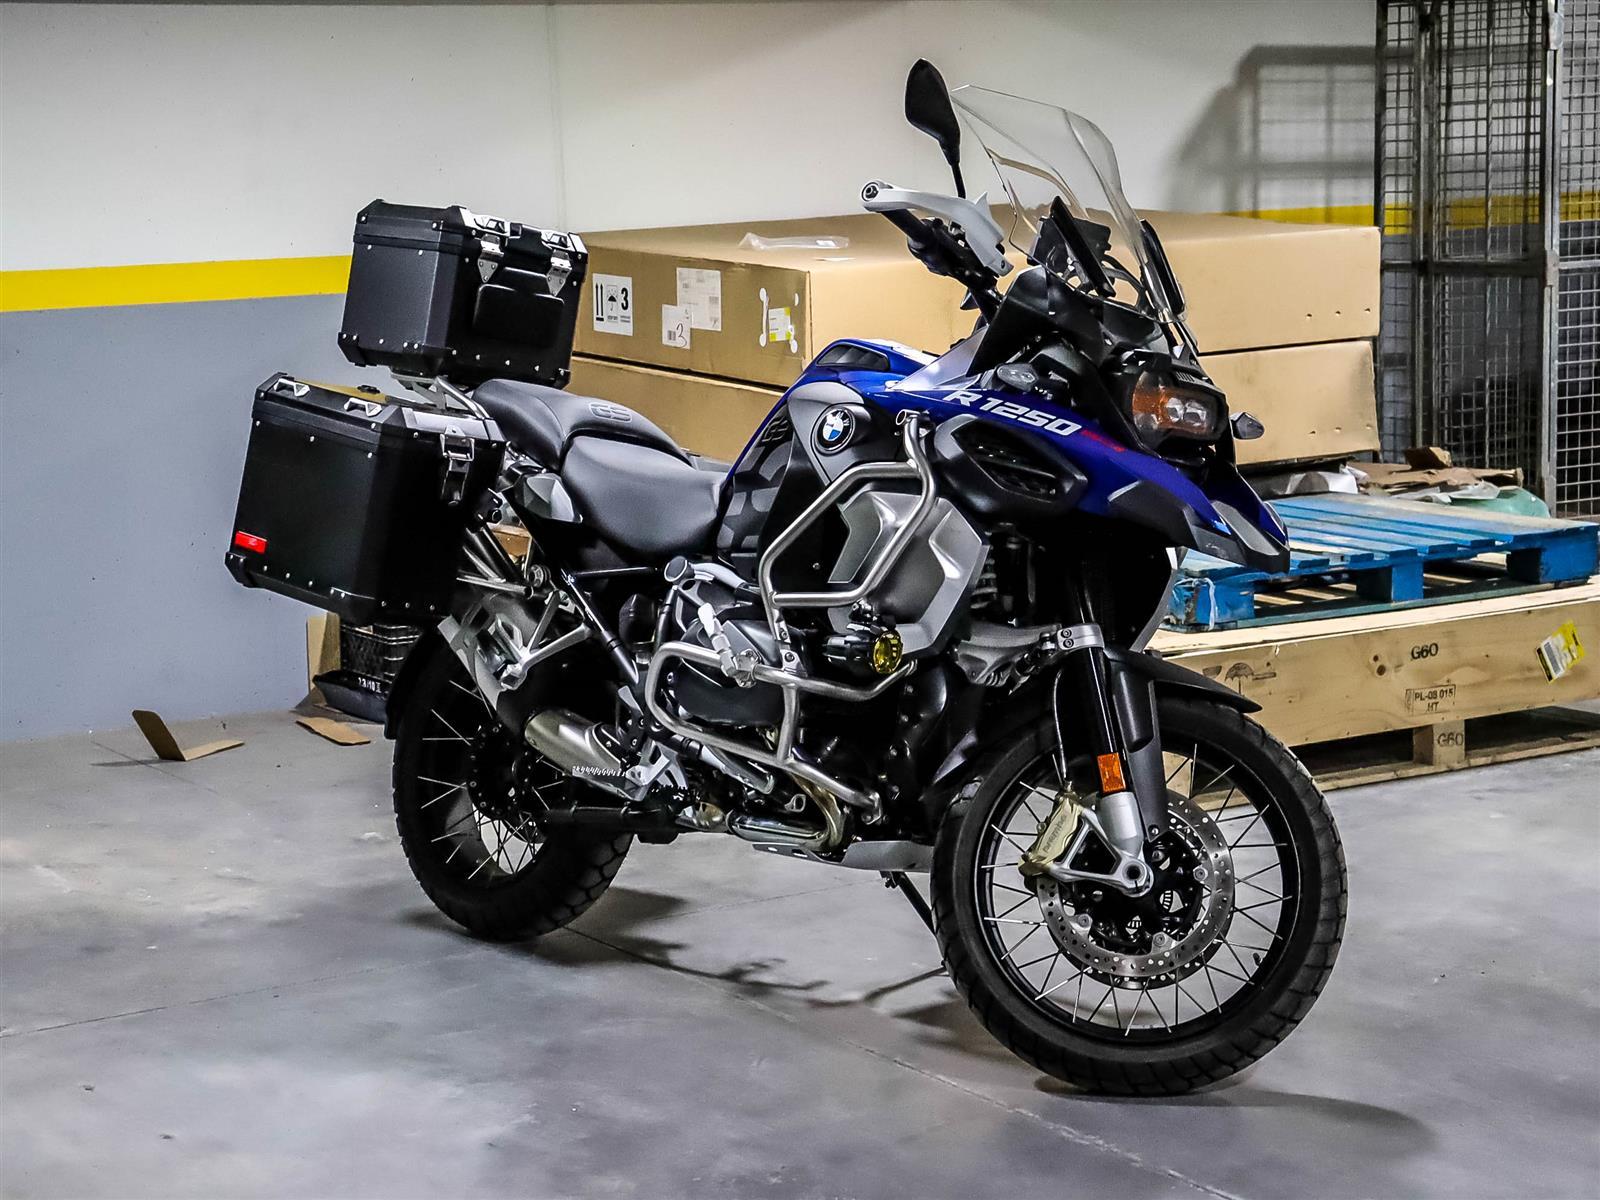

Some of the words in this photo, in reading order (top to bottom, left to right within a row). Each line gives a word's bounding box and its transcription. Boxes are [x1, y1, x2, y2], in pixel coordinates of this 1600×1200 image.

[620, 287, 630, 311] 3
[943, 390, 983, 406] R
[979, 397, 1082, 436] 1250
[1410, 642, 1439, 661] G60
